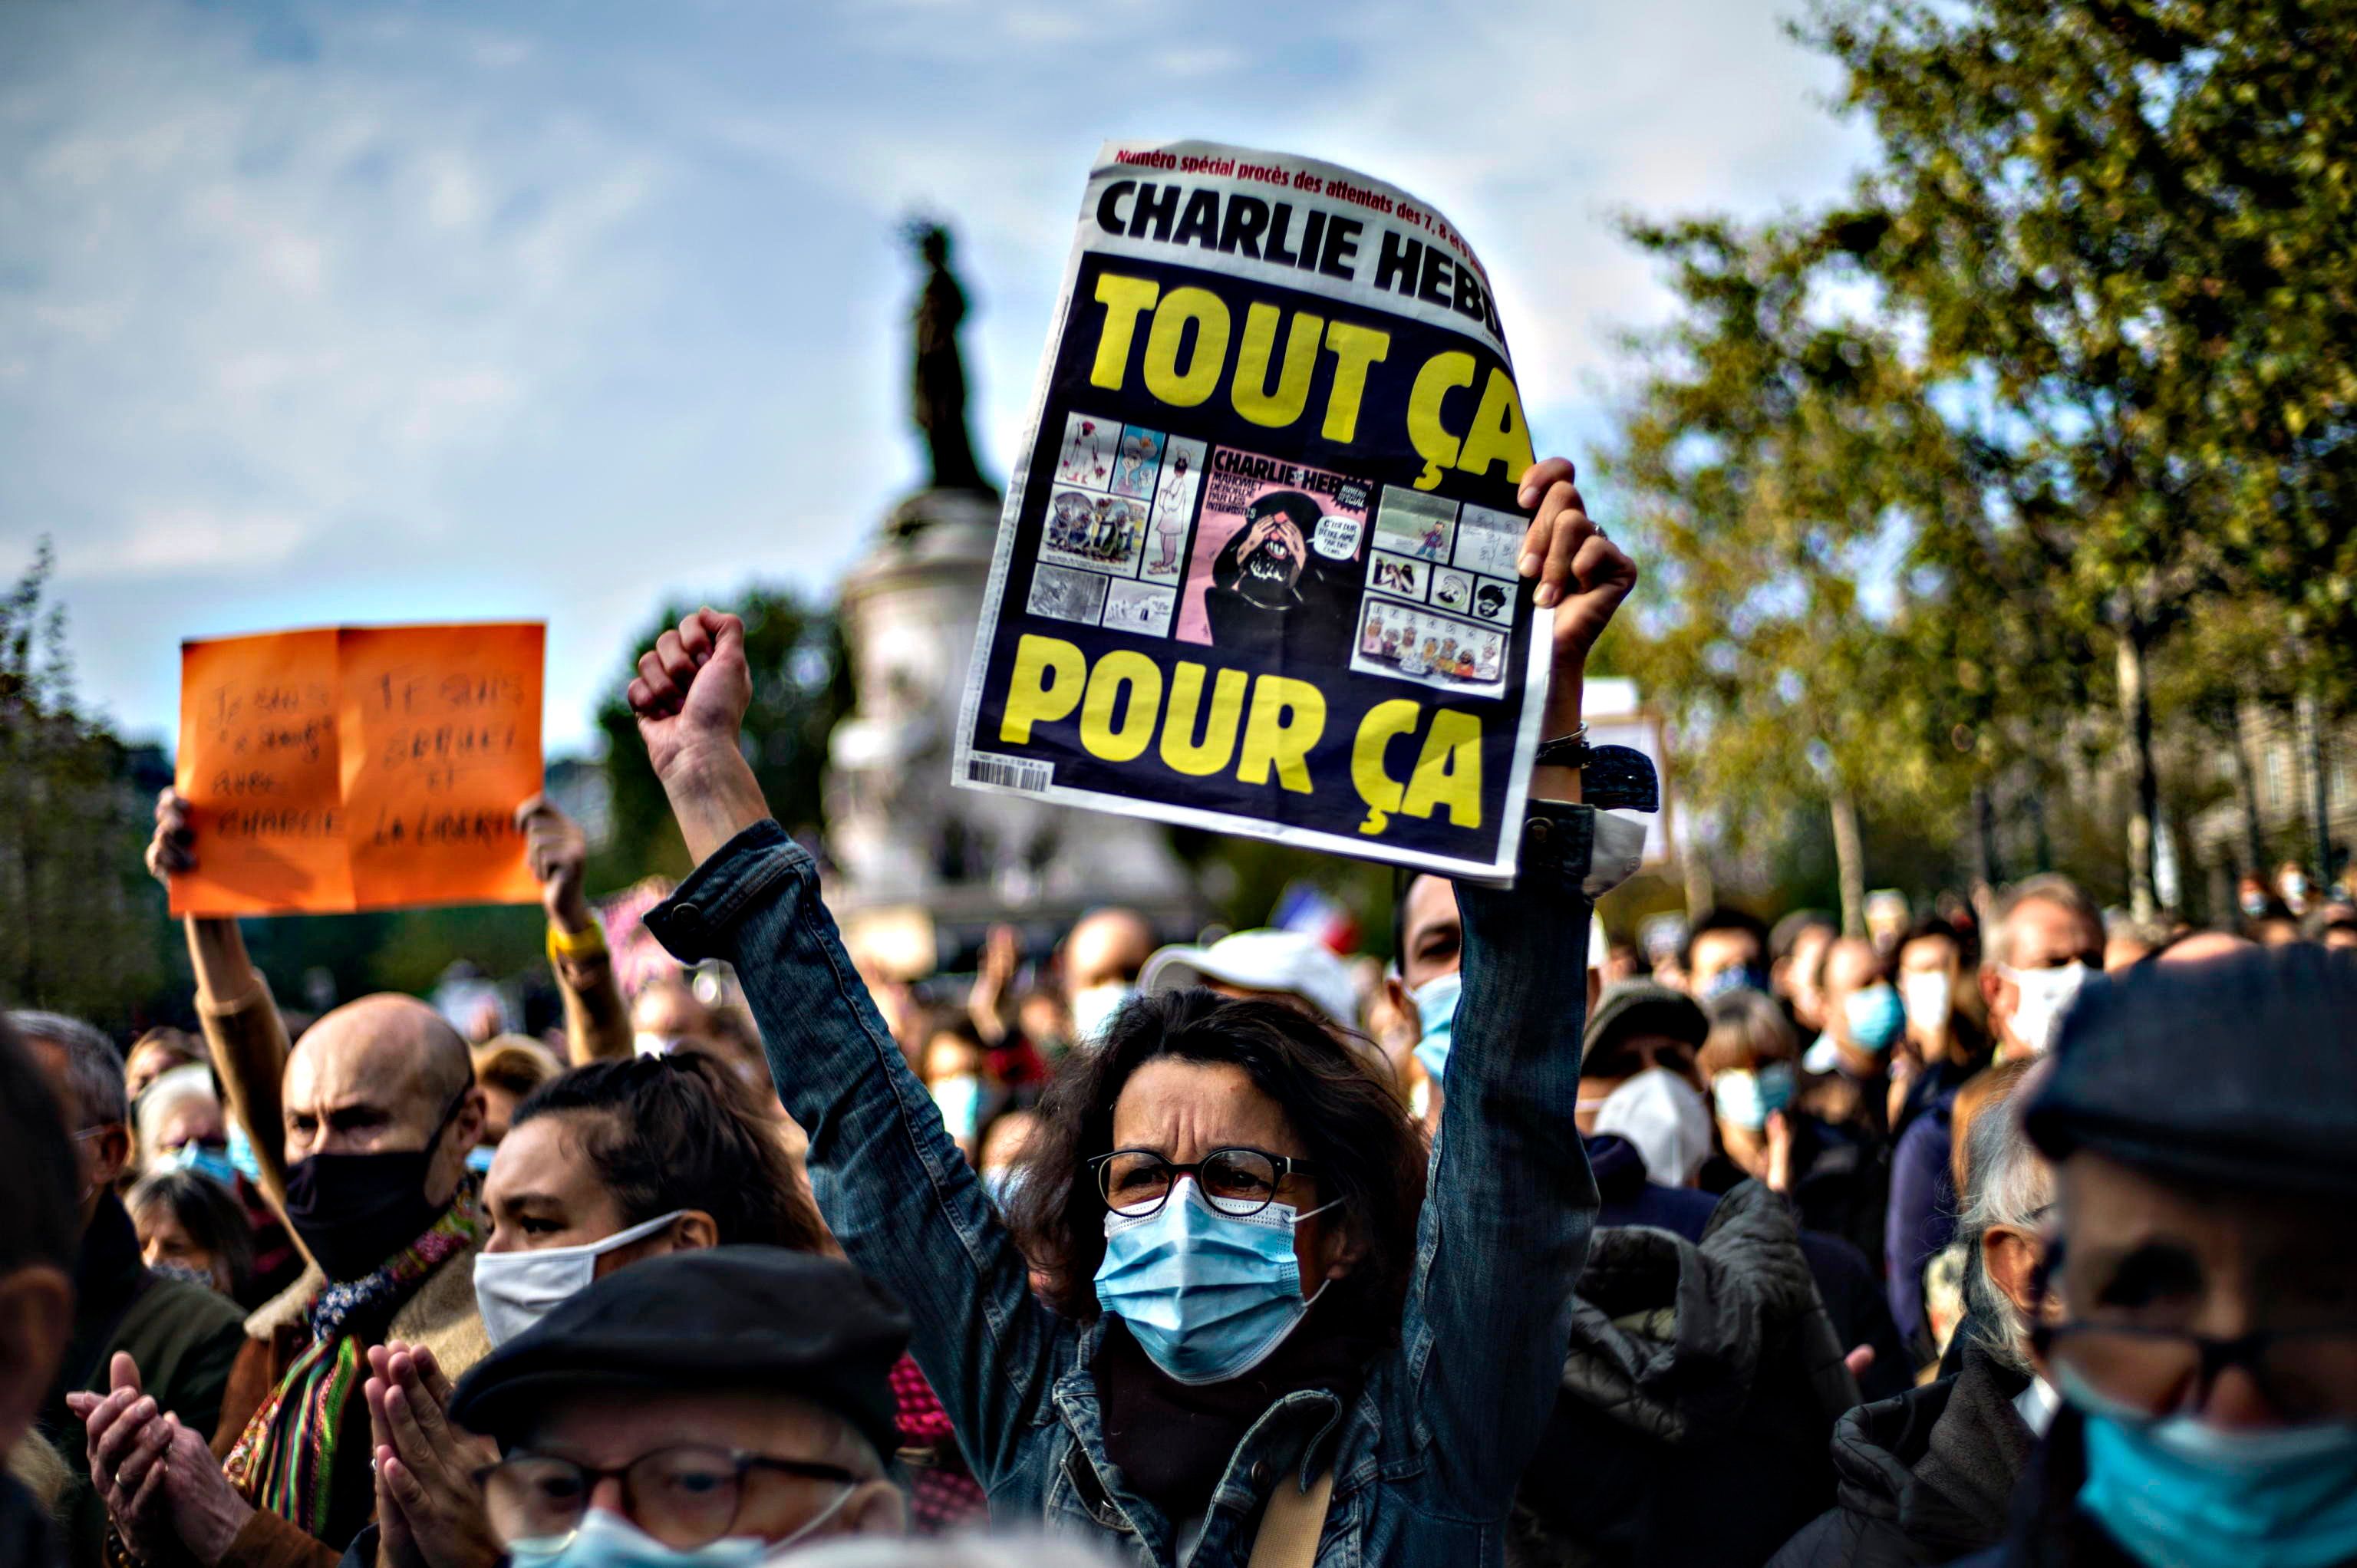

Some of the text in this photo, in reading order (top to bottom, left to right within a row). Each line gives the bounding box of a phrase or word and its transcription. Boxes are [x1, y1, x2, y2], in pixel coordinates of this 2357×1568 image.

[1096, 180, 1363, 280] CHARLIE
[1115, 150, 1176, 170] Numéro
[1180, 155, 1235, 177] spécial
[1237, 163, 1290, 186] procès
[1293, 170, 1323, 194] des
[1326, 179, 1393, 215] attentats
[1396, 202, 1421, 226] des
[1089, 272, 1537, 491] TOUT ÇA
[1213, 450, 1296, 487] CHARLIE
[1213, 472, 1264, 491] MAHOMET
[999, 634, 1327, 795] POUR
[1350, 699, 1482, 835] ÇA
